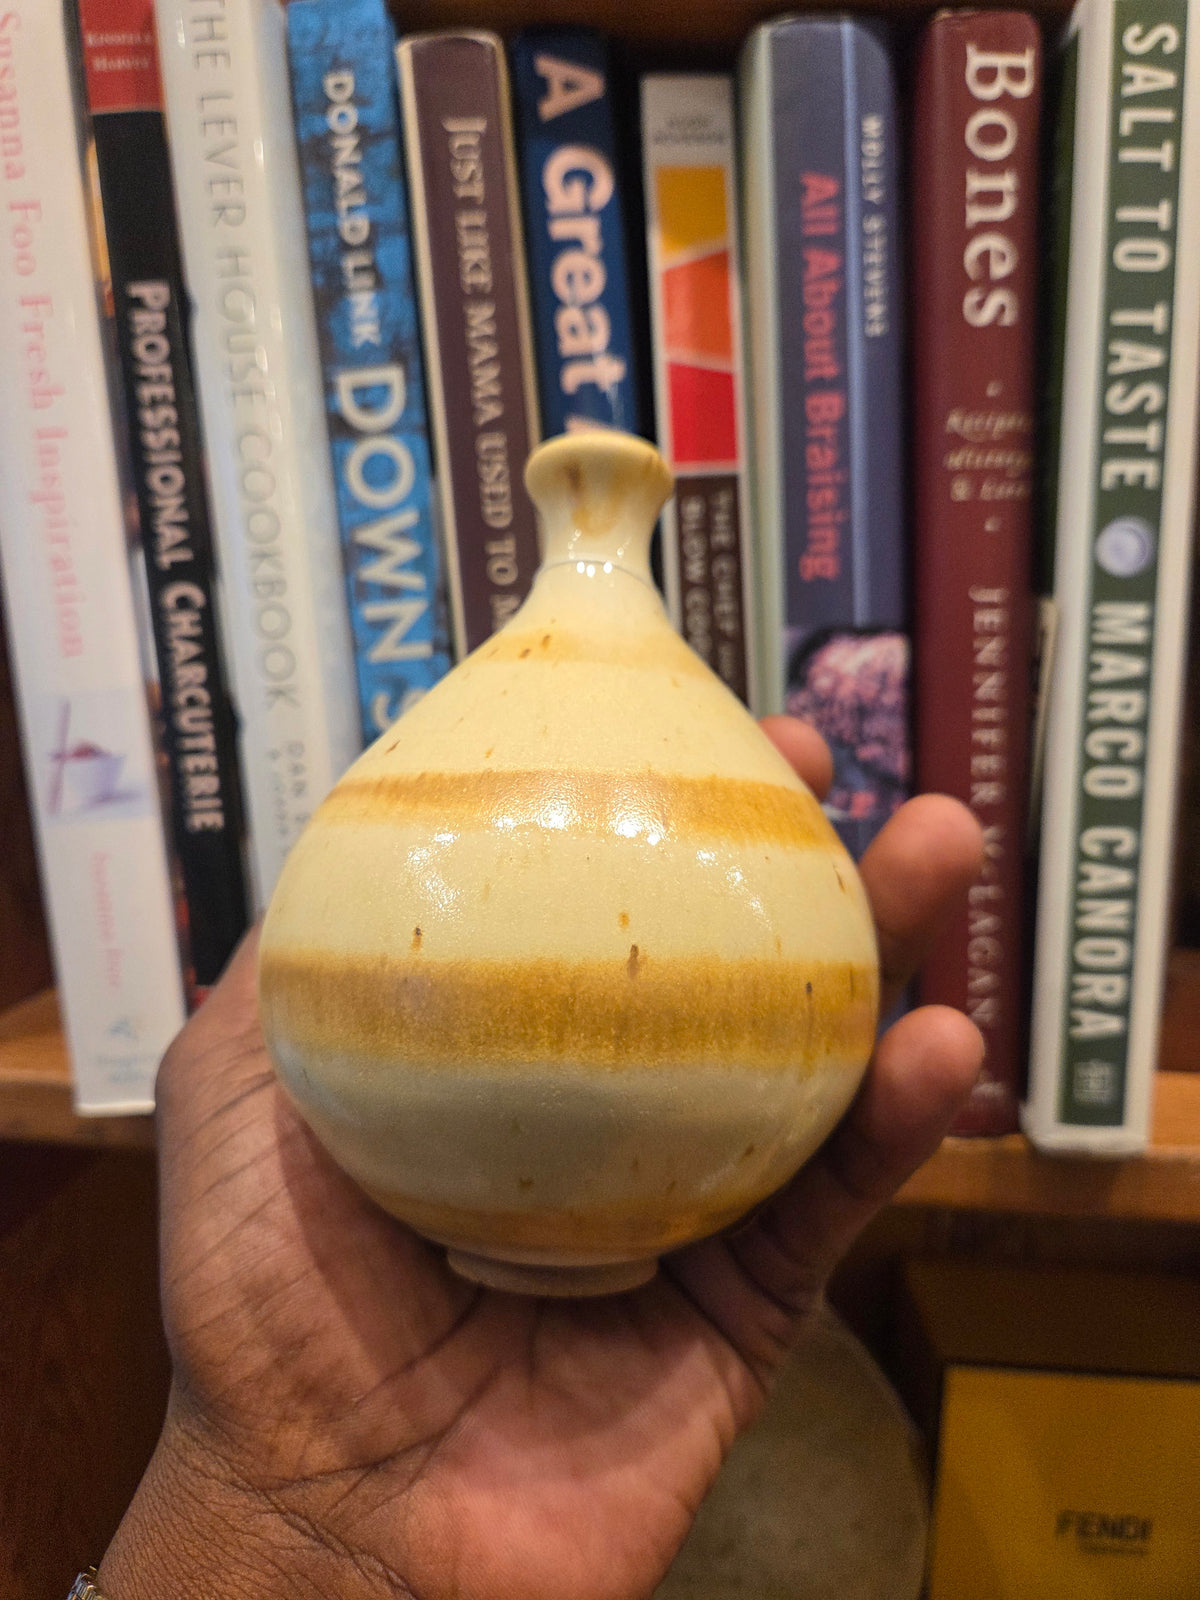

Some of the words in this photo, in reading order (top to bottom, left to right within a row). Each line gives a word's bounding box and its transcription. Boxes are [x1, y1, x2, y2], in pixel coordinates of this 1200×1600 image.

[534, 54, 605, 124] A
[1118, 22, 1180, 172] SALT
[199, 93, 247, 229] LEVER
[323, 70, 370, 247] DONALD
[442, 117, 488, 204] JUST
[800, 171, 839, 236] All
[861, 113, 886, 205] MOLLY
[962, 42, 1036, 328] Bones
[9, 200, 42, 277] Foo
[341, 258, 382, 348] LINK
[457, 211, 493, 295] LIKE
[543, 144, 627, 395] Great
[863, 215, 890, 338] STEVENS
[1113, 201, 1172, 274] TO
[20, 297, 63, 409] Fresh
[216, 249, 264, 407] HOUSE
[465, 303, 504, 426] MAMA
[801, 247, 841, 379] About
[1100, 304, 1168, 491] TASTE
[30, 427, 84, 659] Inspiration
[336, 366, 434, 664] DOWN
[475, 438, 513, 531] USED
[799, 393, 846, 582] Braising
[128, 281, 193, 569] PROFESSIONAL
[163, 580, 226, 833] CHARCUTERIE
[238, 433, 299, 711] COOKBOOK
[484, 539, 519, 587] TO
[968, 585, 1009, 805] JENNIFER
[1081, 600, 1151, 800] MARCO
[1069, 827, 1136, 1040] CANORA
